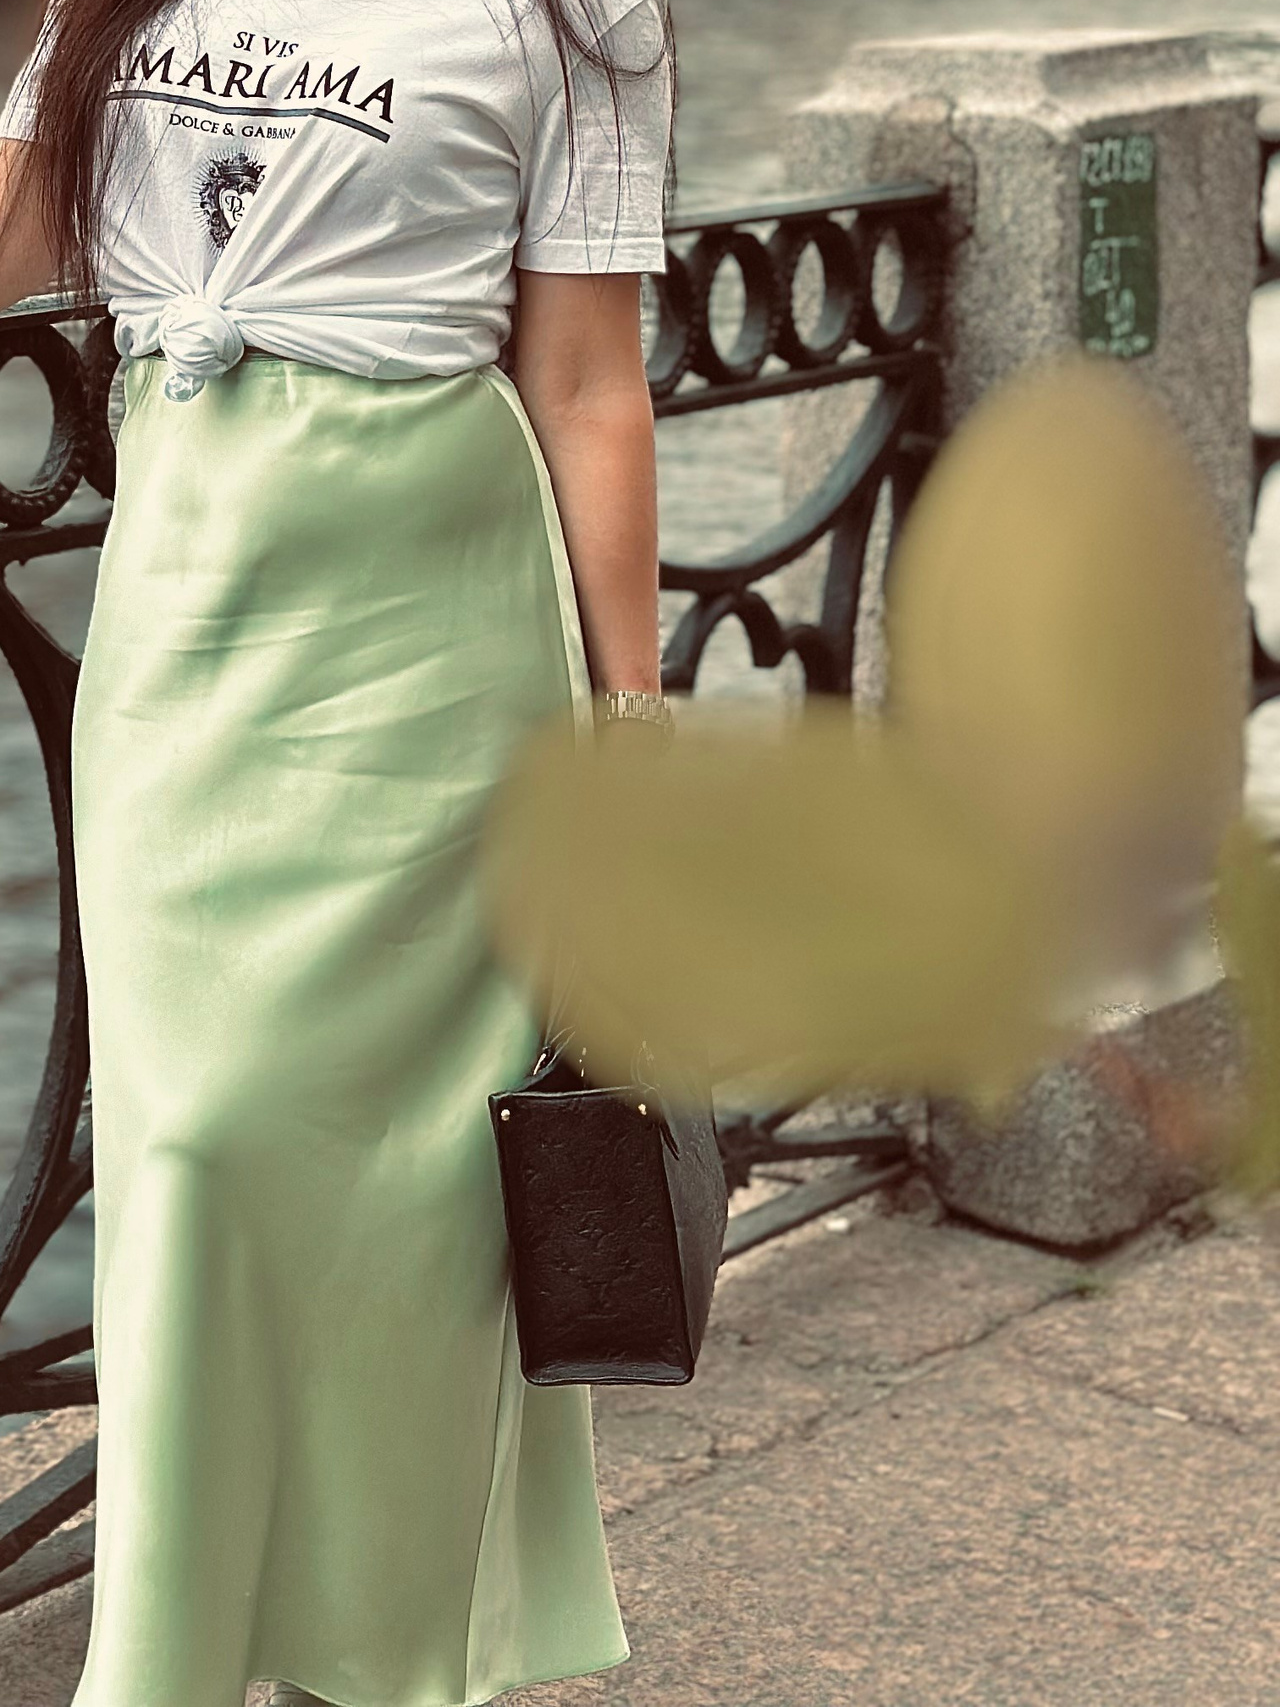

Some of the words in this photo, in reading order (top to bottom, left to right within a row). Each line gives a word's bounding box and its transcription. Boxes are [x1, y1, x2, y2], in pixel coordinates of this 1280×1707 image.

[233, 31, 256, 52] SI
[262, 36, 299, 58] VIS
[284, 60, 395, 124] AMA
[169, 113, 219, 134] DOLCE
[222, 123, 235, 136] &
